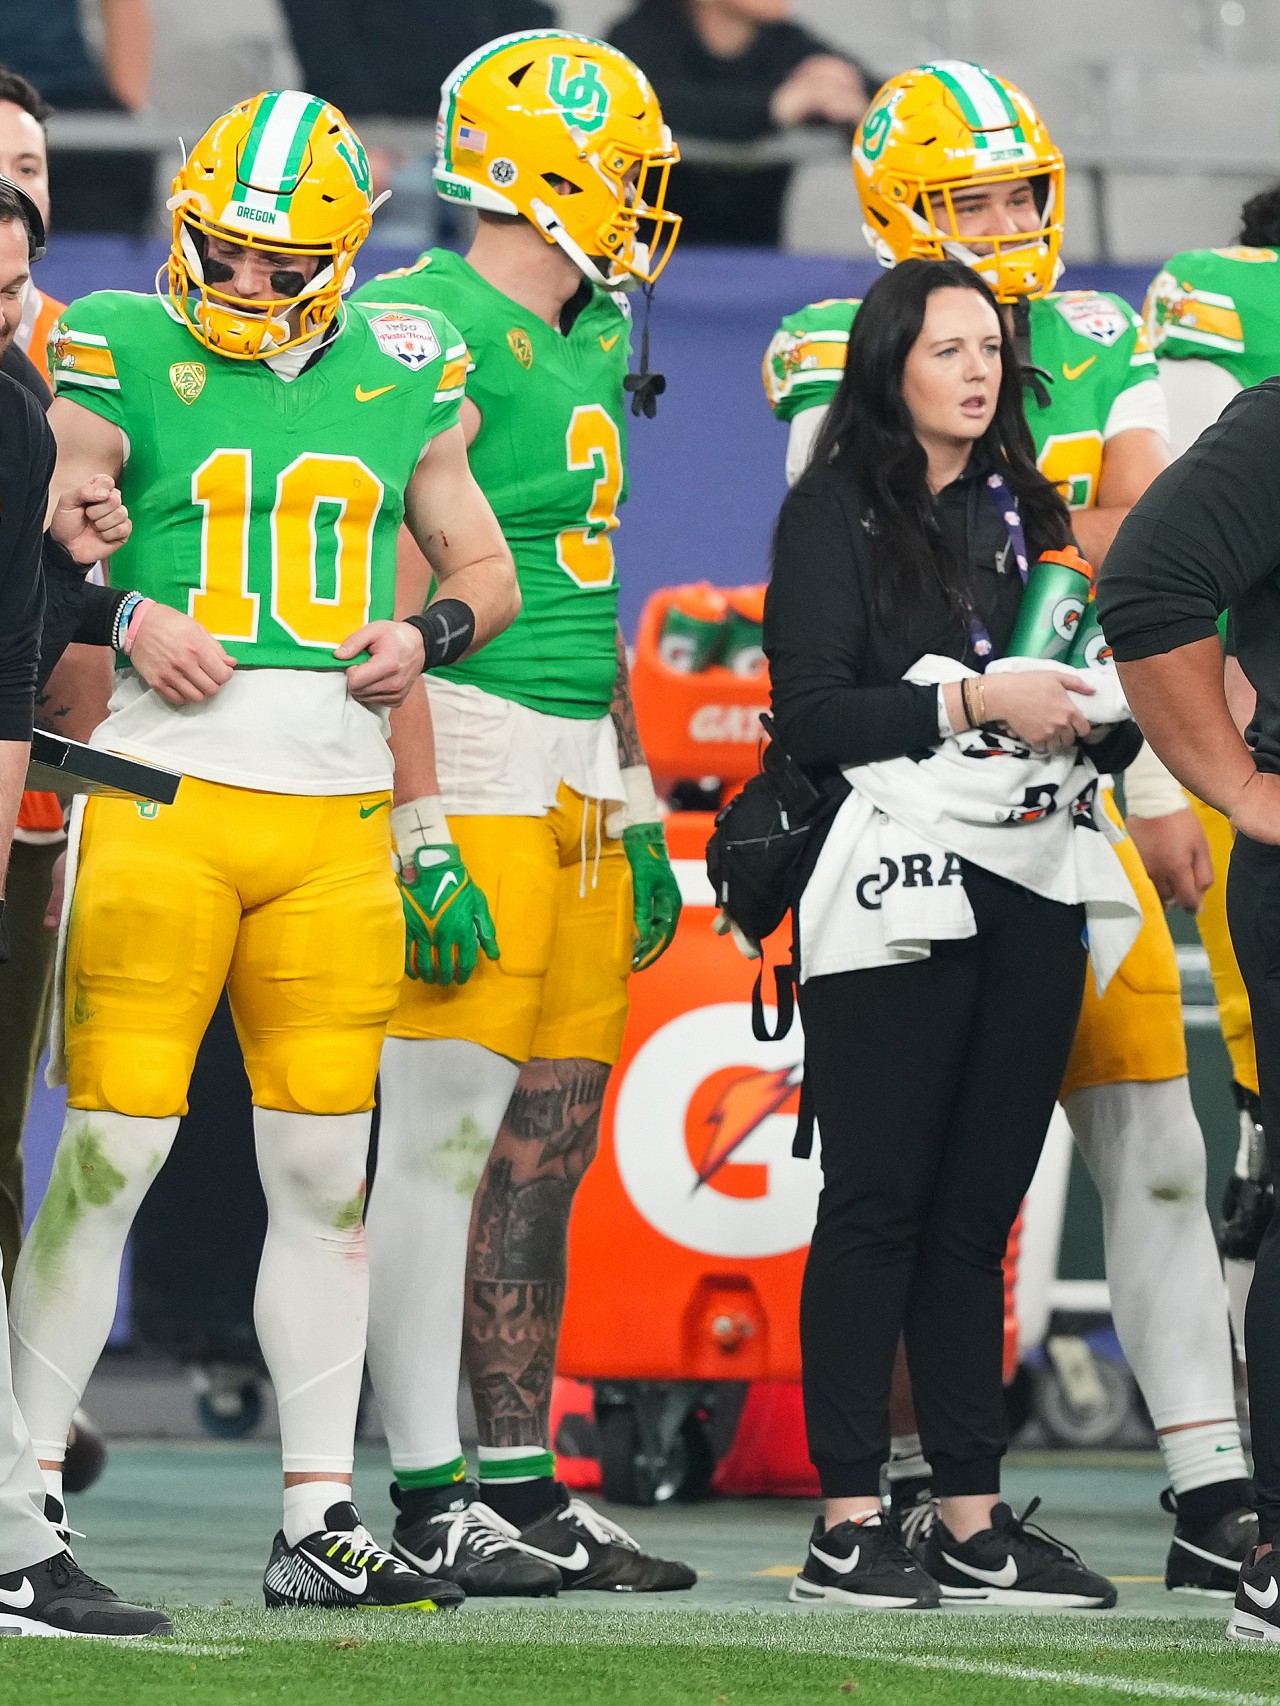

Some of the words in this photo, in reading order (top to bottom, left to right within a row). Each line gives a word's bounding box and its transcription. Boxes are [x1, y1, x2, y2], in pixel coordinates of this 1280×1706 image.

[236, 205, 277, 225] OREGON
[187, 448, 385, 649] 10
[556, 403, 623, 589] 3
